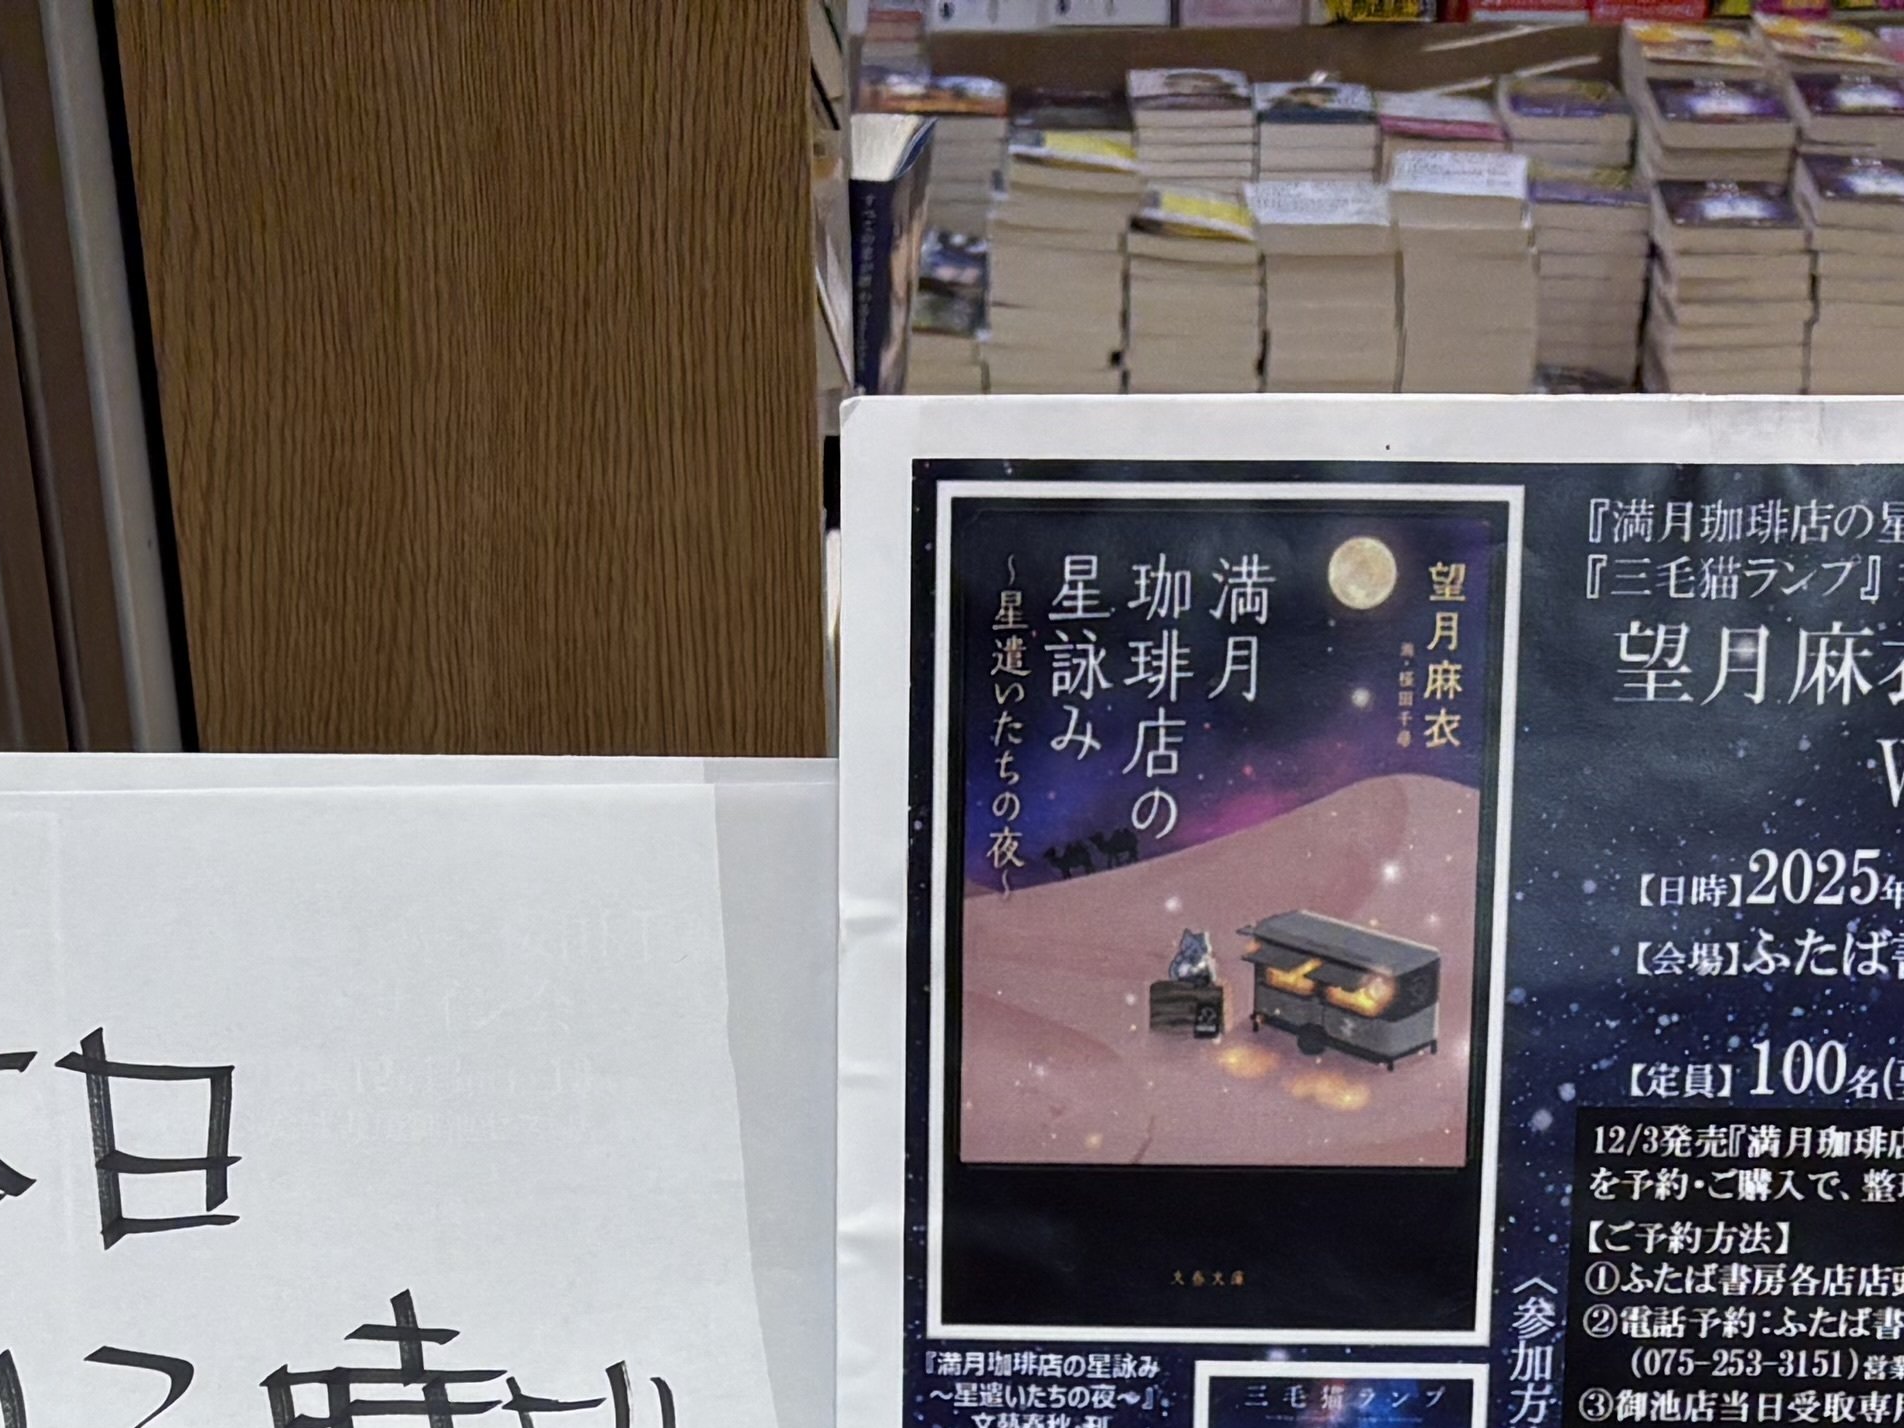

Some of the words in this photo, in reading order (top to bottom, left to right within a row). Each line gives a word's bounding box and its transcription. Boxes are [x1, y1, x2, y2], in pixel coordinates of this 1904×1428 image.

[1208, 554, 1277, 701] 満月
[1584, 558, 1881, 602] 『三毛猫ランプ』
[1045, 554, 1113, 760] 星詠み
[1122, 553, 1194, 840] 珈琲店の
[1423, 561, 1467, 750] 望月麻衣
[1583, 1220, 1794, 1255] 【ご予約方法】
[926, 1351, 1160, 1378] 『満月珈琲店の星詠み
